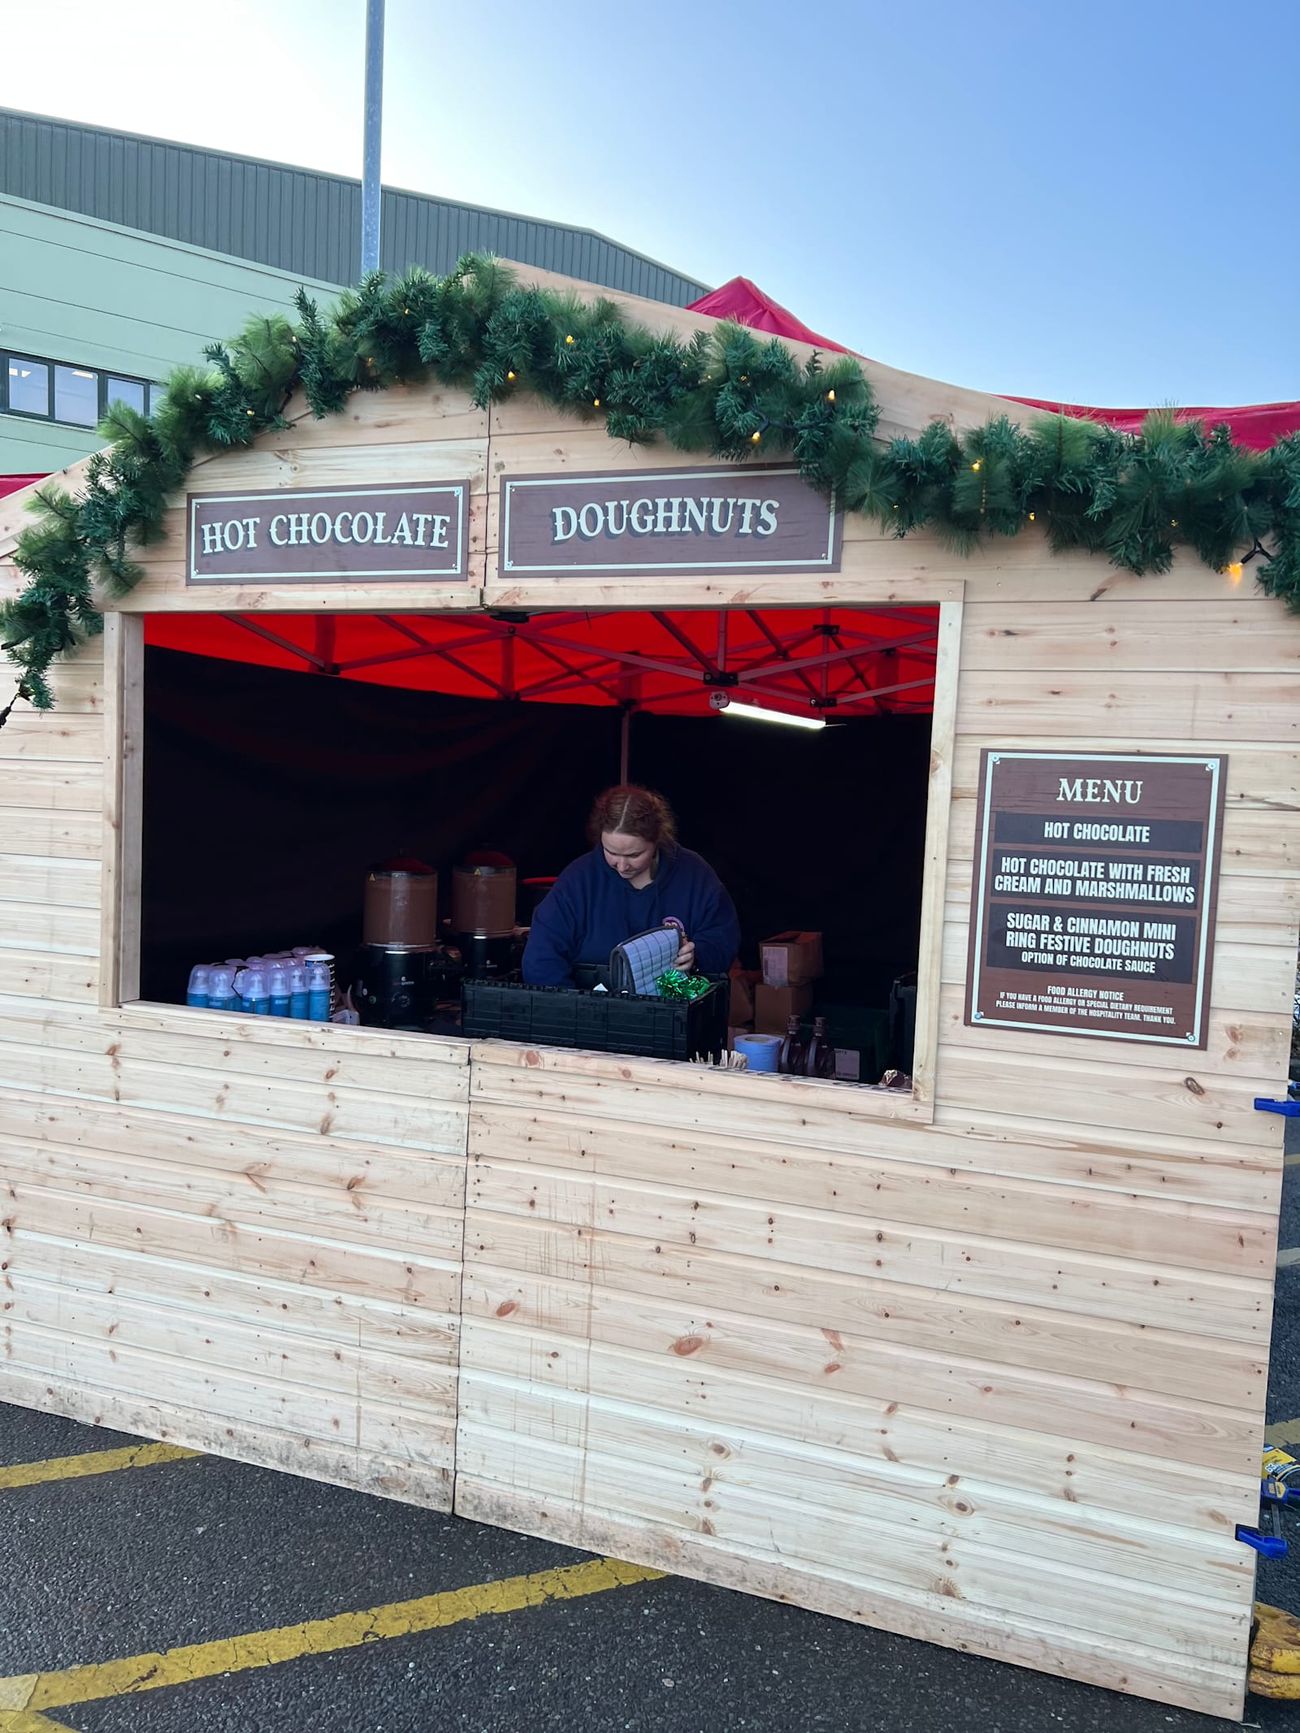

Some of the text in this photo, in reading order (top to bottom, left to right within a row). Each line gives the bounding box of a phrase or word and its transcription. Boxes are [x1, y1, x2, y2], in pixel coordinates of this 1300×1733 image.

[201, 510, 451, 555] HOT CHOCOLATE
[552, 496, 780, 543] DOUGHNUTS
[1056, 778, 1144, 804] MENU
[1044, 822, 1150, 842] HOT CHOCOLATE
[1001, 857, 1190, 883] HOT CHOCOLATE WITH FRESH
[994, 875, 1194, 903] CREAM AND MARSHMALLOWS
[1006, 912, 1176, 940] SUGAR & CINNAMON MINI
[1006, 931, 1174, 960] RING FESTIVE DOUGHNUTS
[1022, 951, 1156, 973] OPTION OF CHOCOLATE SAUCE
[1006, 992, 1017, 1000] YOU
[1018, 993, 1032, 1001] HAVE
[1038, 995, 1052, 1003] FOOD
[1053, 996, 1076, 1006] ALLERGY
[1087, 1000, 1109, 1009] SPECIAL
[1110, 1002, 1132, 1011] DIETARY
[1133, 1004, 1173, 1015] REQUIREMENT
[1048, 986, 1124, 1001] FOOD ALLERGY NOTICE
